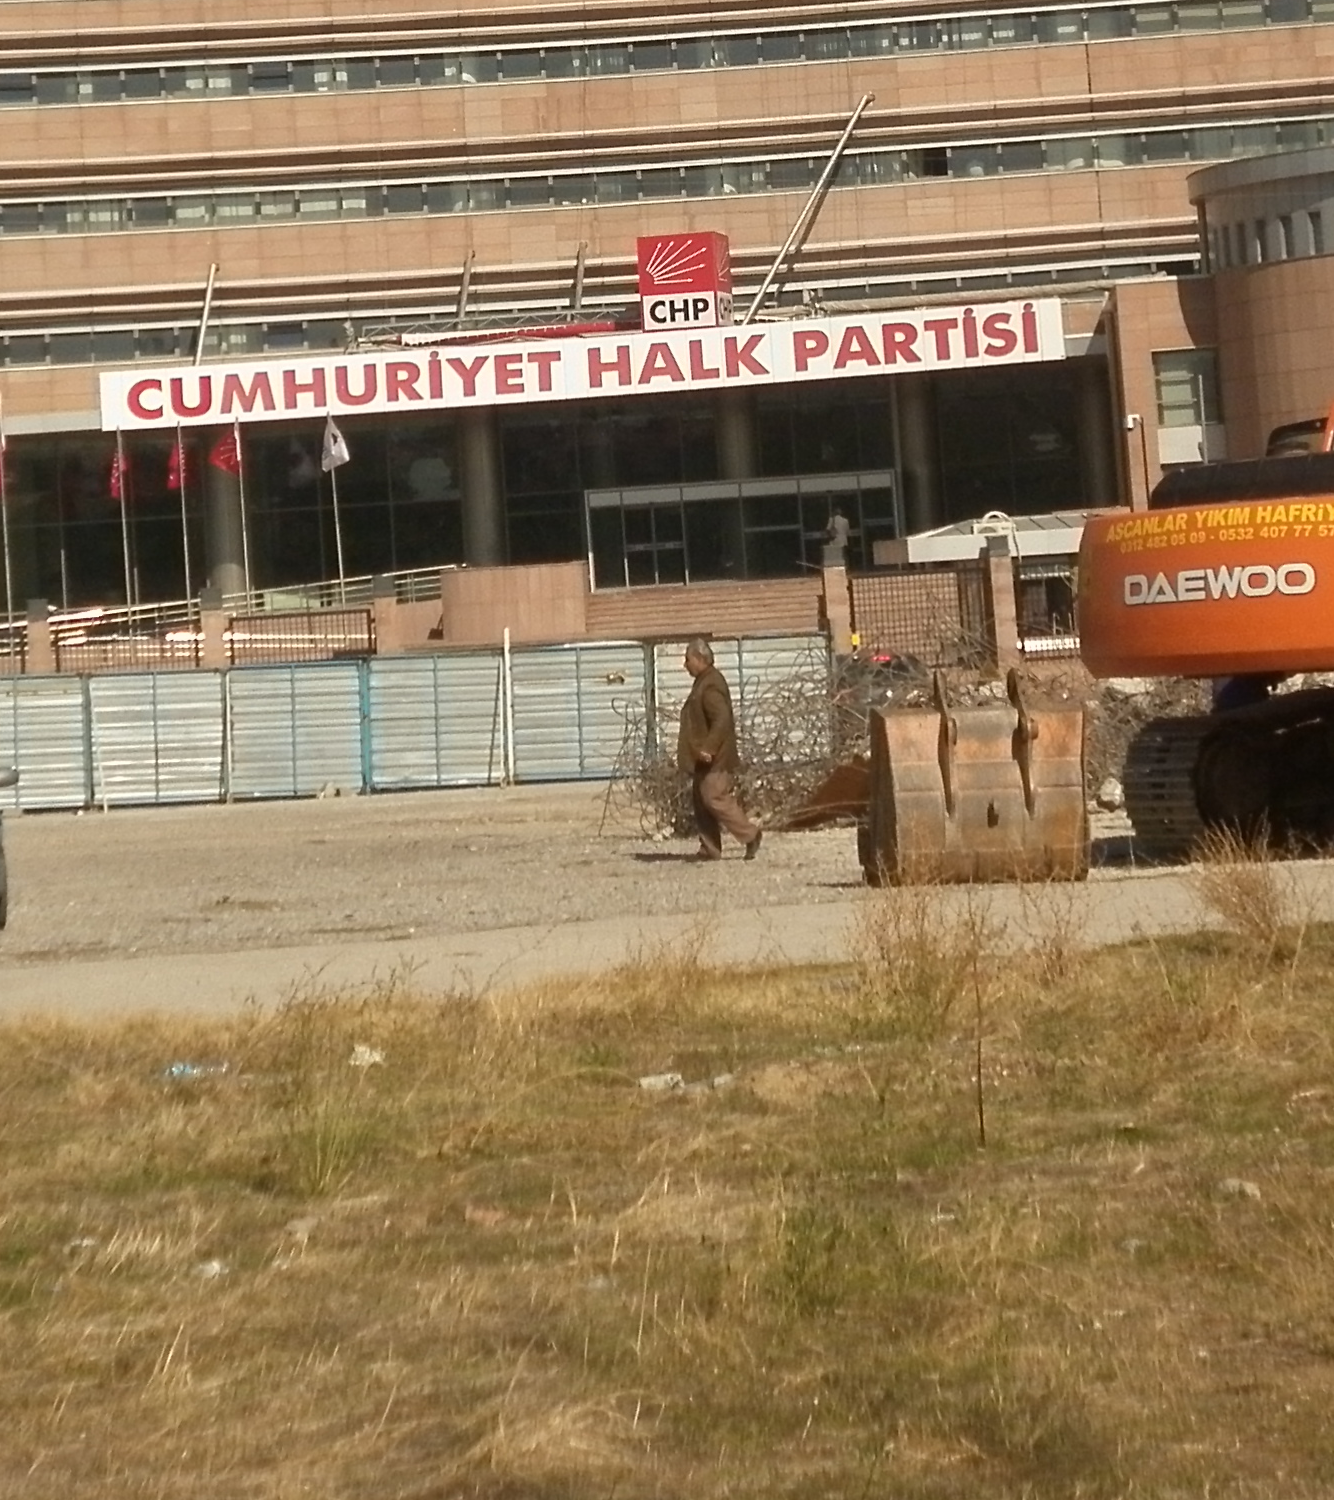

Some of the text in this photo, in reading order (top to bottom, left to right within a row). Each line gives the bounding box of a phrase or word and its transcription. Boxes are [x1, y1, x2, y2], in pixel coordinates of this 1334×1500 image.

[649, 297, 710, 324] CHP
[127, 302, 1040, 420] CUMHURİYET HALK PARTİSİ
[1195, 506, 1251, 528] YIKIM
[1120, 540, 1144, 554] 0312
[1147, 535, 1167, 549] 482
[1170, 533, 1186, 546] 05
[1190, 530, 1206, 544] 09
[1219, 527, 1254, 541] 0532
[1259, 525, 1288, 538] 407
[1293, 524, 1313, 537] 77
[1124, 563, 1316, 606] DAEWOO
